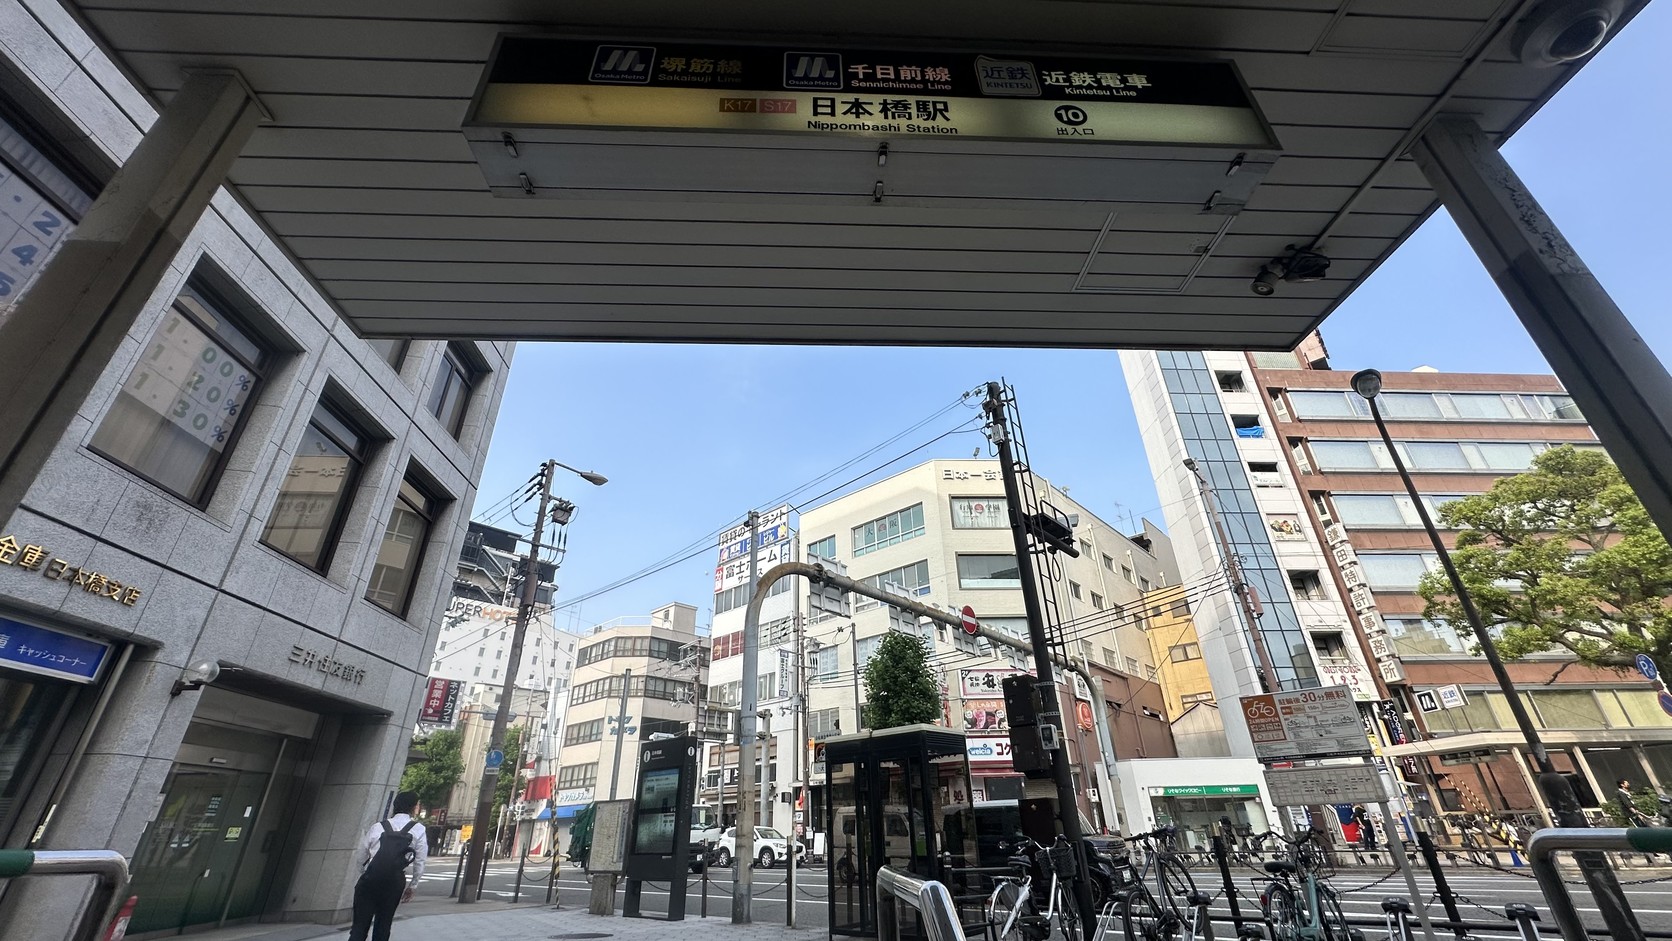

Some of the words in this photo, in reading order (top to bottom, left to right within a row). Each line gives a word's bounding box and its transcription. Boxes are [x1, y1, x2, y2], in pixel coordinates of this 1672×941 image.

[659, 56, 743, 75] 堺筋線
[848, 63, 952, 83] 千日前線
[981, 63, 1032, 83] 近鉄
[621, 73, 646, 81] Metro
[658, 73, 711, 84] Sakaisuji
[717, 75, 742, 83] Line
[788, 79, 814, 87] Osaka
[815, 80, 838, 88] Metro
[1042, 69, 1152, 90] 近鉄電車
[851, 79, 925, 90] Sennichimae
[928, 81, 952, 91] Line
[986, 80, 1034, 91] KINTETSU
[1065, 87, 1110, 97] Kintetsu
[1112, 88, 1137, 97] Line
[723, 99, 753, 112] K17
[764, 101, 792, 113] S17
[812, 97, 951, 123] 日本橋駅
[1056, 108, 1083, 123] 10
[807, 120, 901, 134] Nippombashi
[905, 124, 959, 136] Station
[1056, 127, 1095, 137] 出入口
[943, 469, 1004, 481] 日本一会
[725, 549, 777, 580] 富士ーム
[1327, 526, 1397, 680] 鎌田特許事務所
[17, 644, 87, 667] キャッシュコーナー
[288, 645, 366, 685] 三井住友銀行
[429, 679, 445, 708] 営業中
[441, 681, 459, 722] ネットカフェ
[1442, 690, 1456, 699] 近鉄
